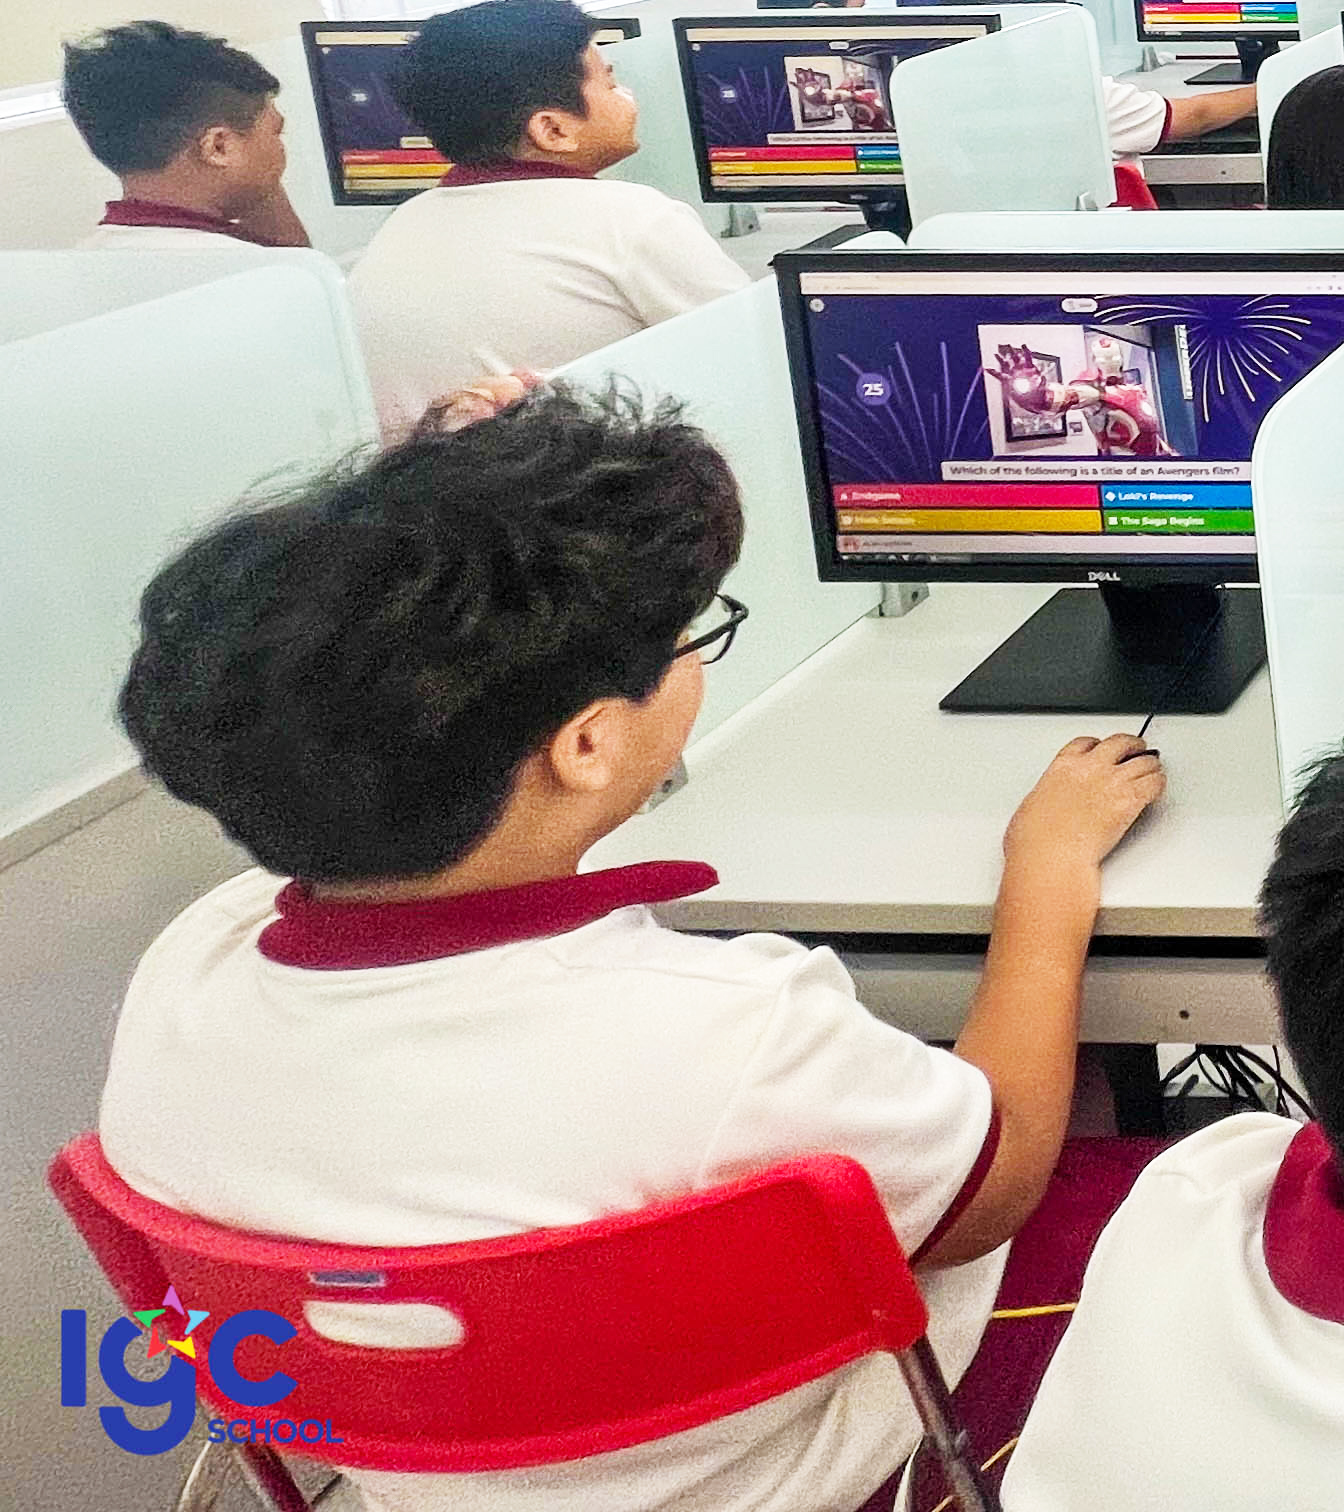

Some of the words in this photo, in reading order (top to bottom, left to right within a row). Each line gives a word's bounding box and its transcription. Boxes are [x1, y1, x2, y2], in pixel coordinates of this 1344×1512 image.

[863, 381, 884, 396] 25
[949, 466, 986, 477] Which
[988, 466, 1000, 477] of
[1003, 466, 1022, 477] the
[1024, 466, 1078, 479] following
[1080, 466, 1089, 477] is
[1126, 466, 1137, 477] of
[1139, 468, 1154, 477] an
[1157, 466, 1210, 479] Avengers
[1212, 466, 1240, 477] film?
[1120, 515, 1141, 526] The
[1141, 515, 1168, 528] Saga
[1169, 515, 1205, 528] Begins
[1088, 570, 1121, 582] DELL
